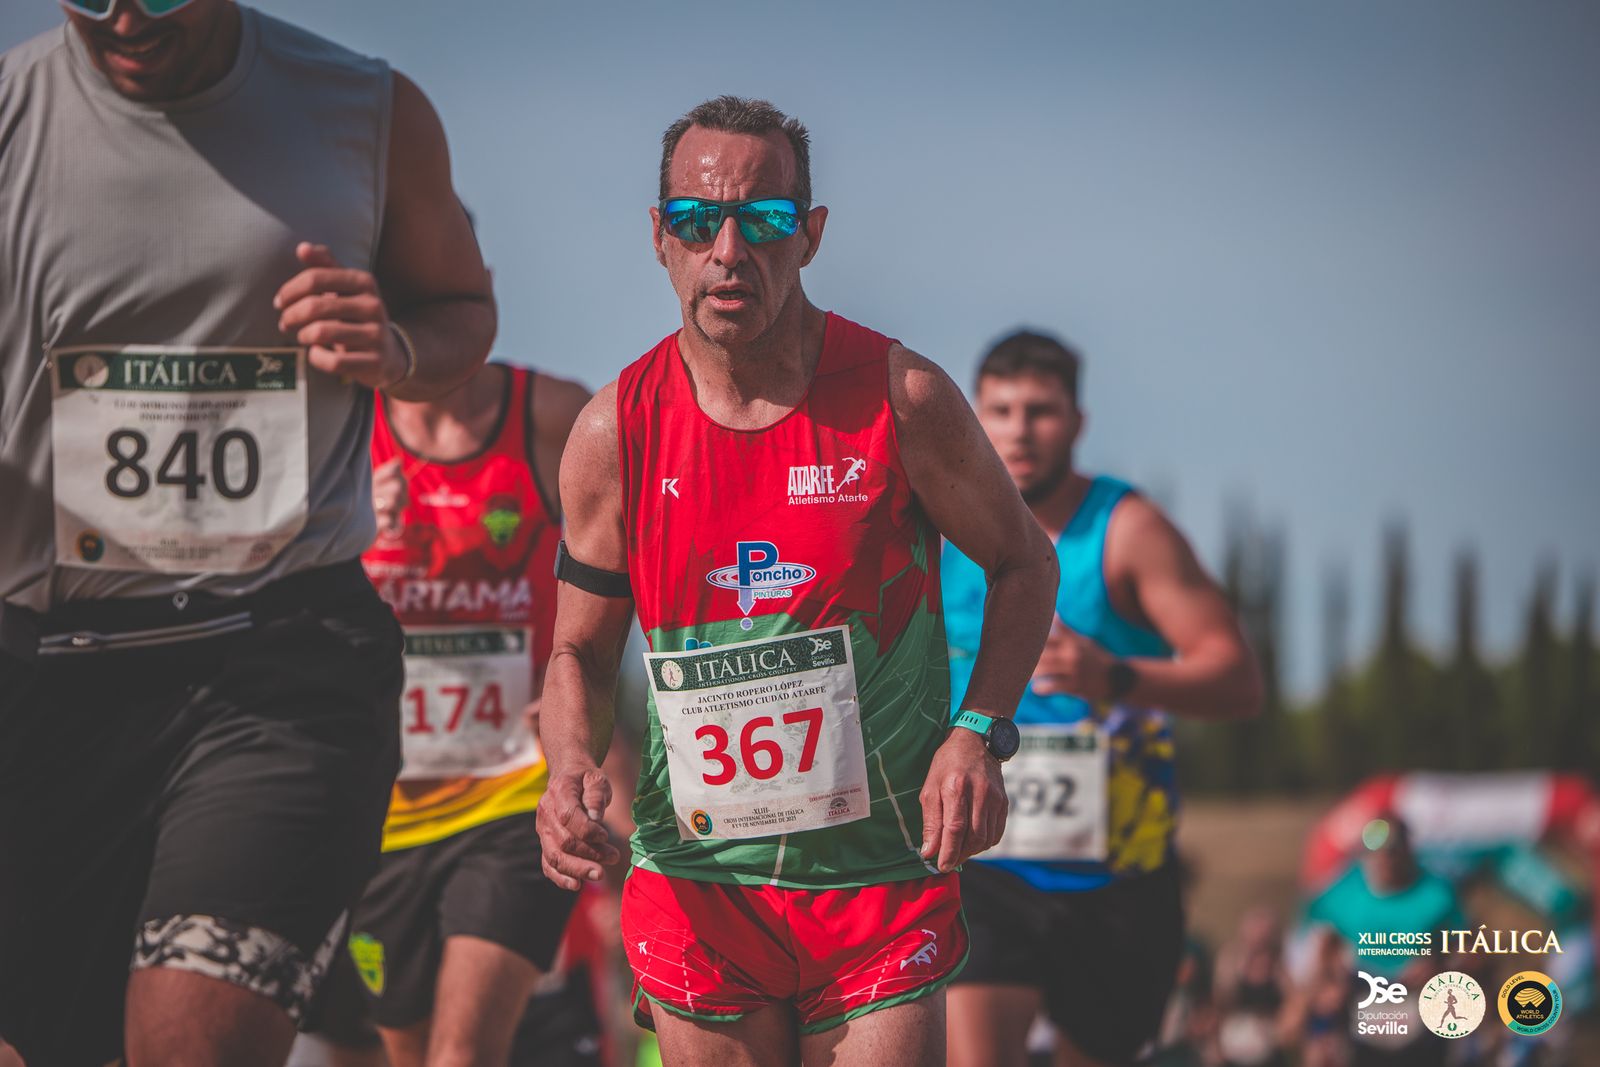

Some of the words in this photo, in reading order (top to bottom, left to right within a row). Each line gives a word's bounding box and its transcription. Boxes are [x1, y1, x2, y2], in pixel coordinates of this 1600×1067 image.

[123, 354, 237, 385] ITÁLICA
[105, 428, 260, 500] 840
[787, 465, 835, 497] ATARFE
[788, 493, 835, 506] Atletismo
[837, 493, 869, 503] Atarfe
[737, 541, 802, 586] Poncho
[379, 578, 532, 611] ARTAMA
[753, 589, 792, 599] PINTURAS
[694, 647, 796, 682] ITÁLICA
[698, 675, 746, 688] INTERNATIONAL
[748, 671, 768, 681] CROSS
[769, 666, 797, 677] COUNTRY
[681, 706, 703, 716] CLUB
[704, 699, 753, 714] ATLETISMO
[755, 692, 790, 706] CIUDAD
[791, 685, 827, 700] ATARFE
[698, 692, 734, 704] JACINTO
[736, 686, 772, 699] ROPERO
[775, 680, 804, 692] LÓPEZ
[405, 683, 507, 734] 174
[694, 707, 824, 786] 367
[738, 812, 776, 823] INTERNACIONAL
[777, 810, 785, 818] DE
[749, 817, 778, 827] NOVIEMBRE
